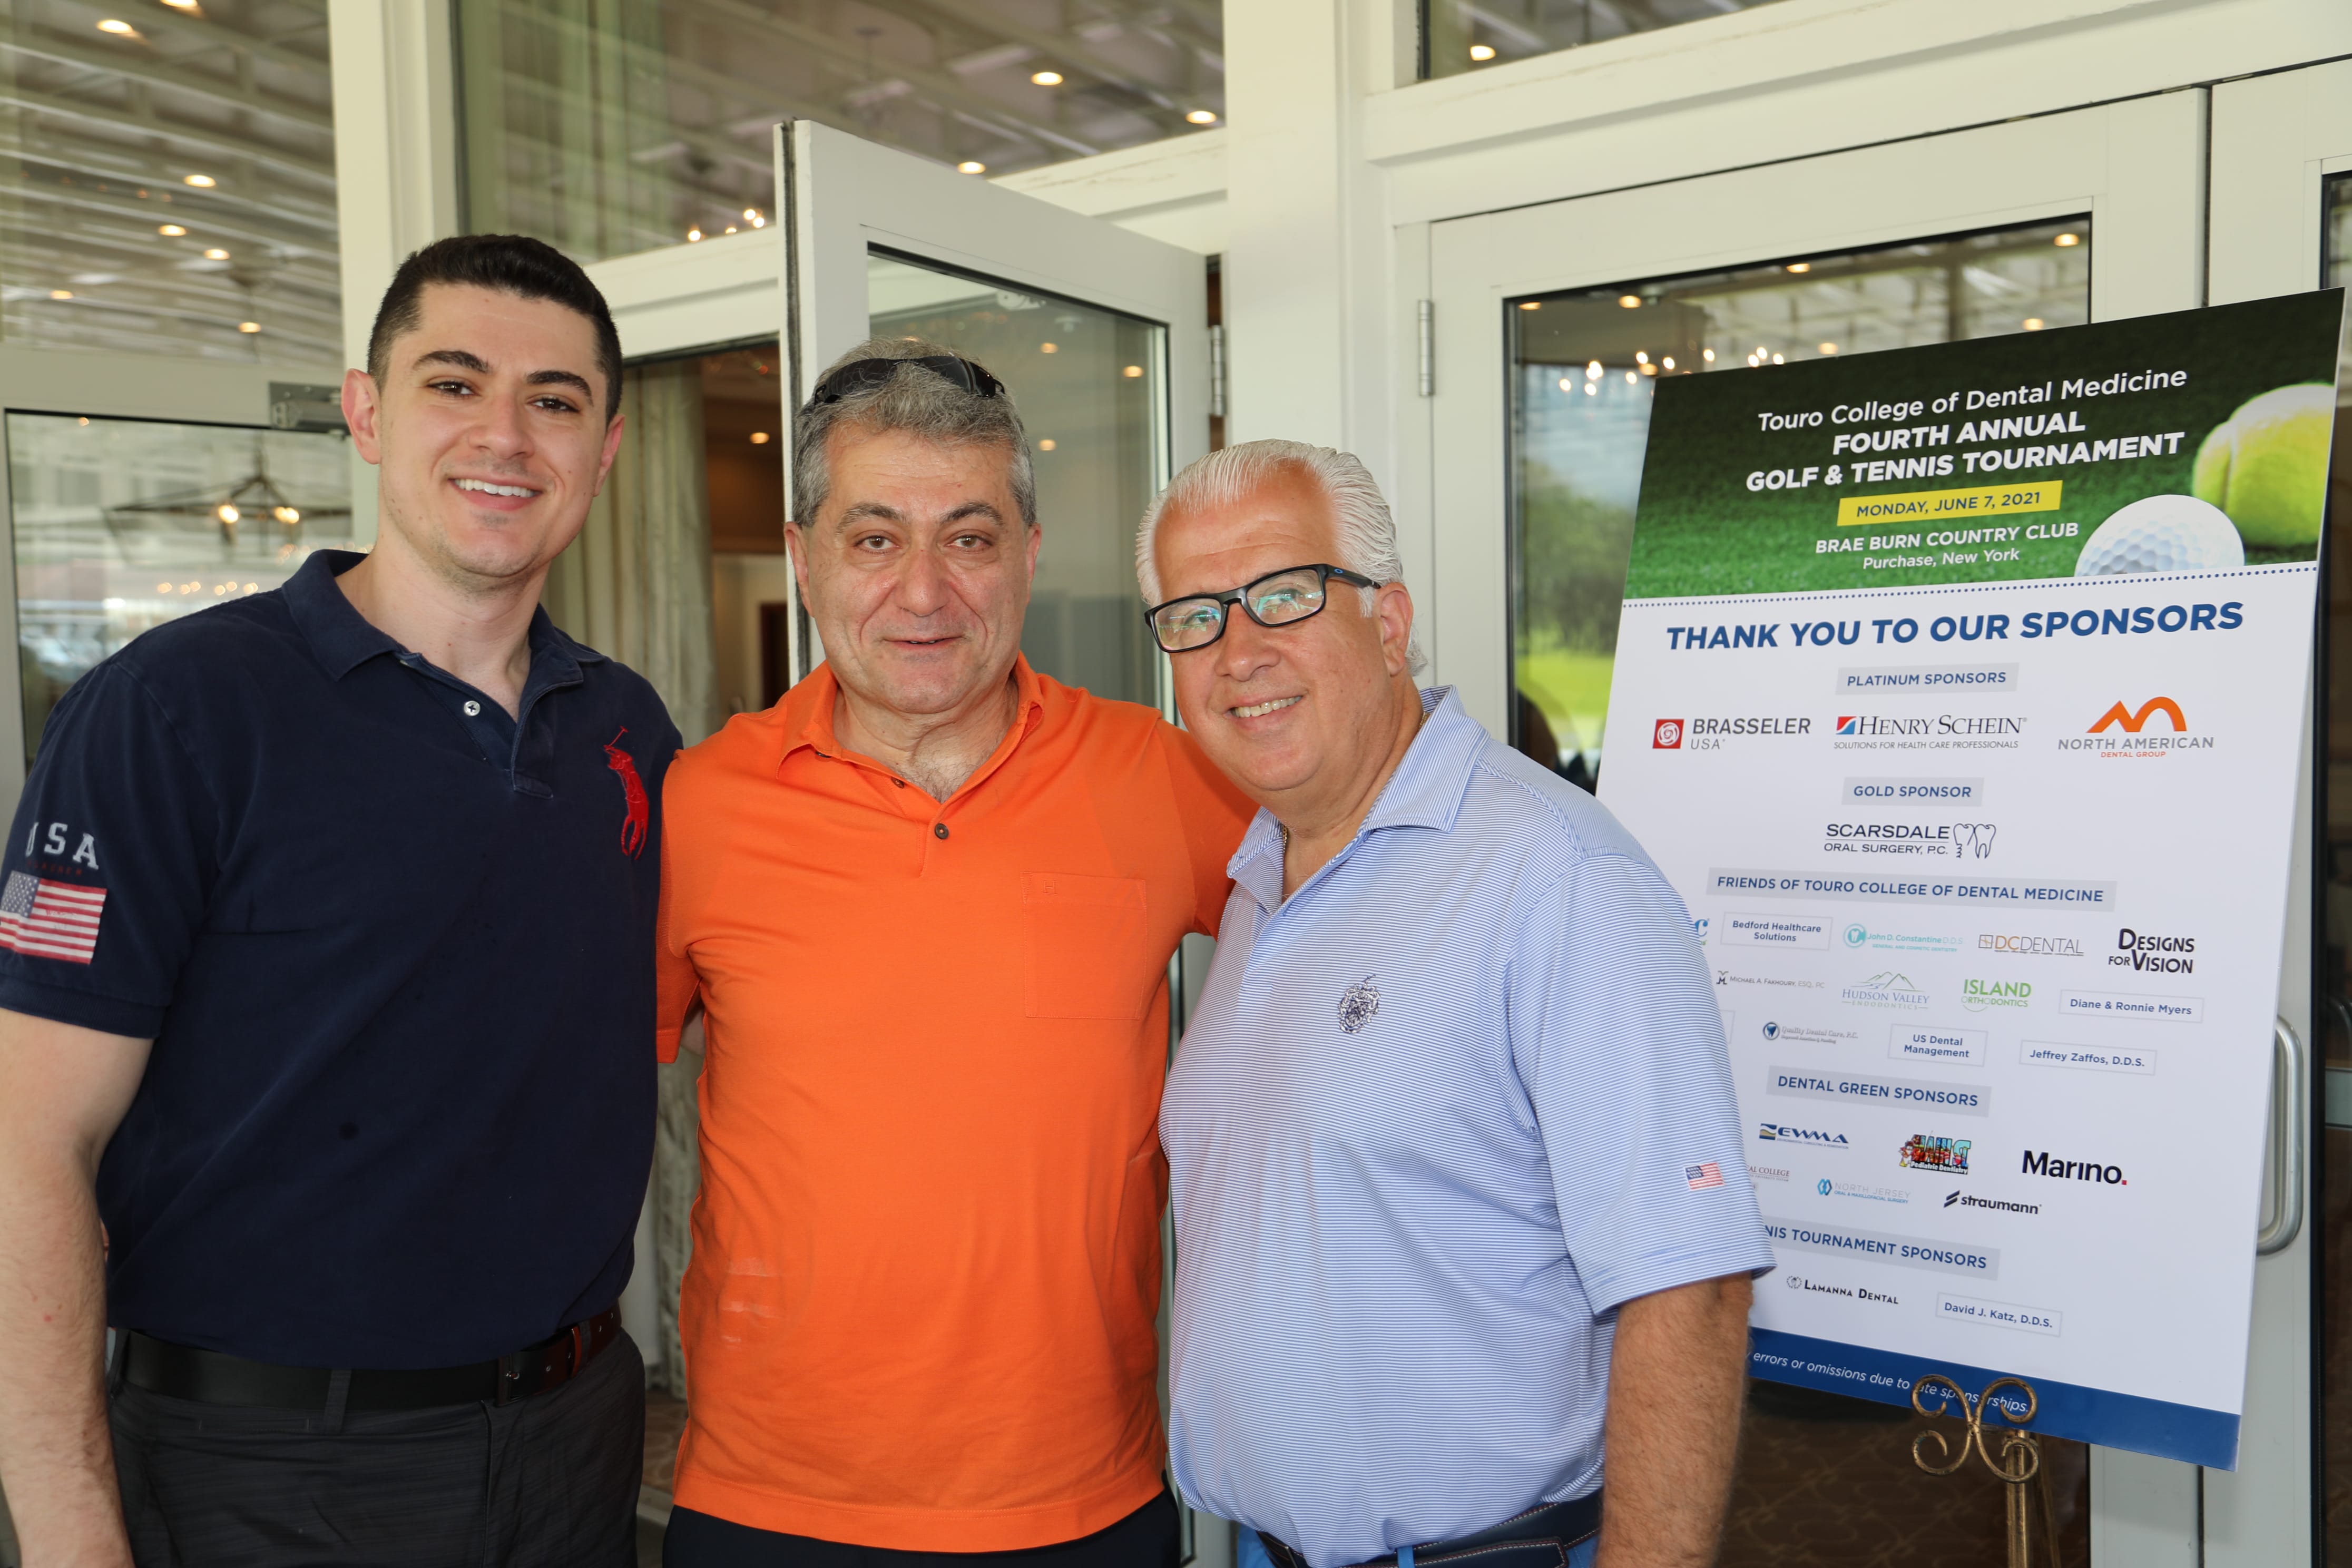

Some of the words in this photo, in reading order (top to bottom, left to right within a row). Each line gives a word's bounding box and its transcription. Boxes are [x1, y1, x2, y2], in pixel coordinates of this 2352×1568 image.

[1758, 409, 1824, 433] Touro
[1831, 397, 1924, 425] College
[1931, 391, 1959, 414] of
[1966, 383, 2052, 411] Dental
[2061, 370, 2188, 400] Medicine
[1833, 425, 1949, 456] FOURTH
[1956, 411, 2085, 443] ANNUAL
[1746, 466, 1818, 491] GOLF
[1824, 464, 1844, 485] &
[1850, 454, 1953, 484] TENNIS
[1962, 432, 2186, 474] TOURNAMENT
[1856, 500, 1928, 519] MONDAY,
[1933, 496, 1978, 513] JUNE
[1984, 495, 1997, 513] 7,
[2001, 491, 2041, 507] 2021
[1815, 536, 1865, 554] BRAE
[1869, 533, 1921, 552] BURN
[1925, 526, 2021, 548] COUNTRY
[2025, 523, 2079, 540] CLUB
[1863, 552, 1937, 571] Purchase,
[1941, 550, 1977, 565] New
[1981, 546, 2020, 563] York
[1667, 624, 1780, 650] THANK
[1790, 620, 1863, 648] YOU
[1871, 618, 1918, 644] TO
[1929, 612, 2011, 643] OUR
[2020, 601, 2244, 639] SPONSORS
[1847, 674, 1919, 687] PLATINUM
[1924, 670, 2006, 685] SPONSORS
[1693, 718, 1811, 734] BRASSELER
[1856, 716, 1935, 734] HENRY
[2058, 739, 2115, 750] NORTH
[2122, 737, 2214, 749] AMERICAN
[1854, 786, 1894, 797] GOLD
[1899, 786, 1972, 798] SPONSOR
[1826, 824, 1950, 839] SCARSDALE
[1824, 843, 1858, 852] ORAL
[1862, 844, 1923, 856] SURGERY,
[1927, 845, 1948, 855] P.C.
[1718, 877, 1776, 888] FRIENDS
[1780, 879, 1800, 889] OF
[1805, 880, 1854, 892] TOURO
[1859, 882, 1927, 895] COLLEGE
[1932, 885, 1953, 896] OF
[1958, 886, 2018, 899] DENTAL
[2024, 888, 2103, 901] MEDICINE
[1732, 920, 1769, 929] Bedford
[1772, 923, 1821, 933] Healthcare
[1754, 932, 1796, 942] Solutions
[1896, 935, 1942, 943] Constantine
[1995, 935, 2084, 953] DCDENTAL
[2108, 956, 2130, 966] FOR
[1843, 989, 1888, 1001] HUDSON
[1893, 992, 1929, 1003] VALLEY
[1963, 979, 2031, 997] ISLAND
[1851, 1001, 1917, 1010] ENDODONTICS
[1961, 996, 2028, 1007] ORTHODONTICS
[2070, 998, 2101, 1008] Diane
[2104, 1001, 2112, 1010] &
[2116, 1002, 2154, 1012] Ronnie
[2158, 1005, 2191, 1016] Myers
[1782, 1026, 1805, 1035] Quality
[1929, 1036, 1963, 1046] Dental
[1904, 1045, 1969, 1059] Management
[2029, 1050, 2067, 1061] Jeffrey
[2071, 1053, 2108, 1065] Zaffos,
[2112, 1056, 2145, 1066] D.D.S.
[1778, 1076, 1834, 1092] DENTAL
[1839, 1082, 1889, 1097] GREEN
[1894, 1087, 1978, 1106] SPONSORS
[1778, 1126, 1848, 1143] EWMA
[1759, 1167, 1790, 1177] COLLEGE
[1911, 1161, 1938, 1170] Pediatric
[1939, 1165, 1967, 1174] Dentistry
[1835, 1183, 1868, 1193] NORTH
[1874, 1187, 1911, 1198] JERSEY
[1766, 1225, 1787, 1238] NIS
[1791, 1229, 1896, 1255] TOURNAMENT
[1900, 1246, 1987, 1268] SPONSORS
[1944, 1302, 1975, 1315] David
[1978, 1308, 1986, 1317] J.
[1990, 1310, 2016, 1323] Katz,
[2021, 1315, 2052, 1328] D.D.S.
[1753, 1353, 1788, 1366] errors
[1791, 1359, 1805, 1369] or
[1807, 1362, 1866, 1381] omissions
[1869, 1373, 1894, 1386] due
[1897, 1377, 1910, 1389] to
